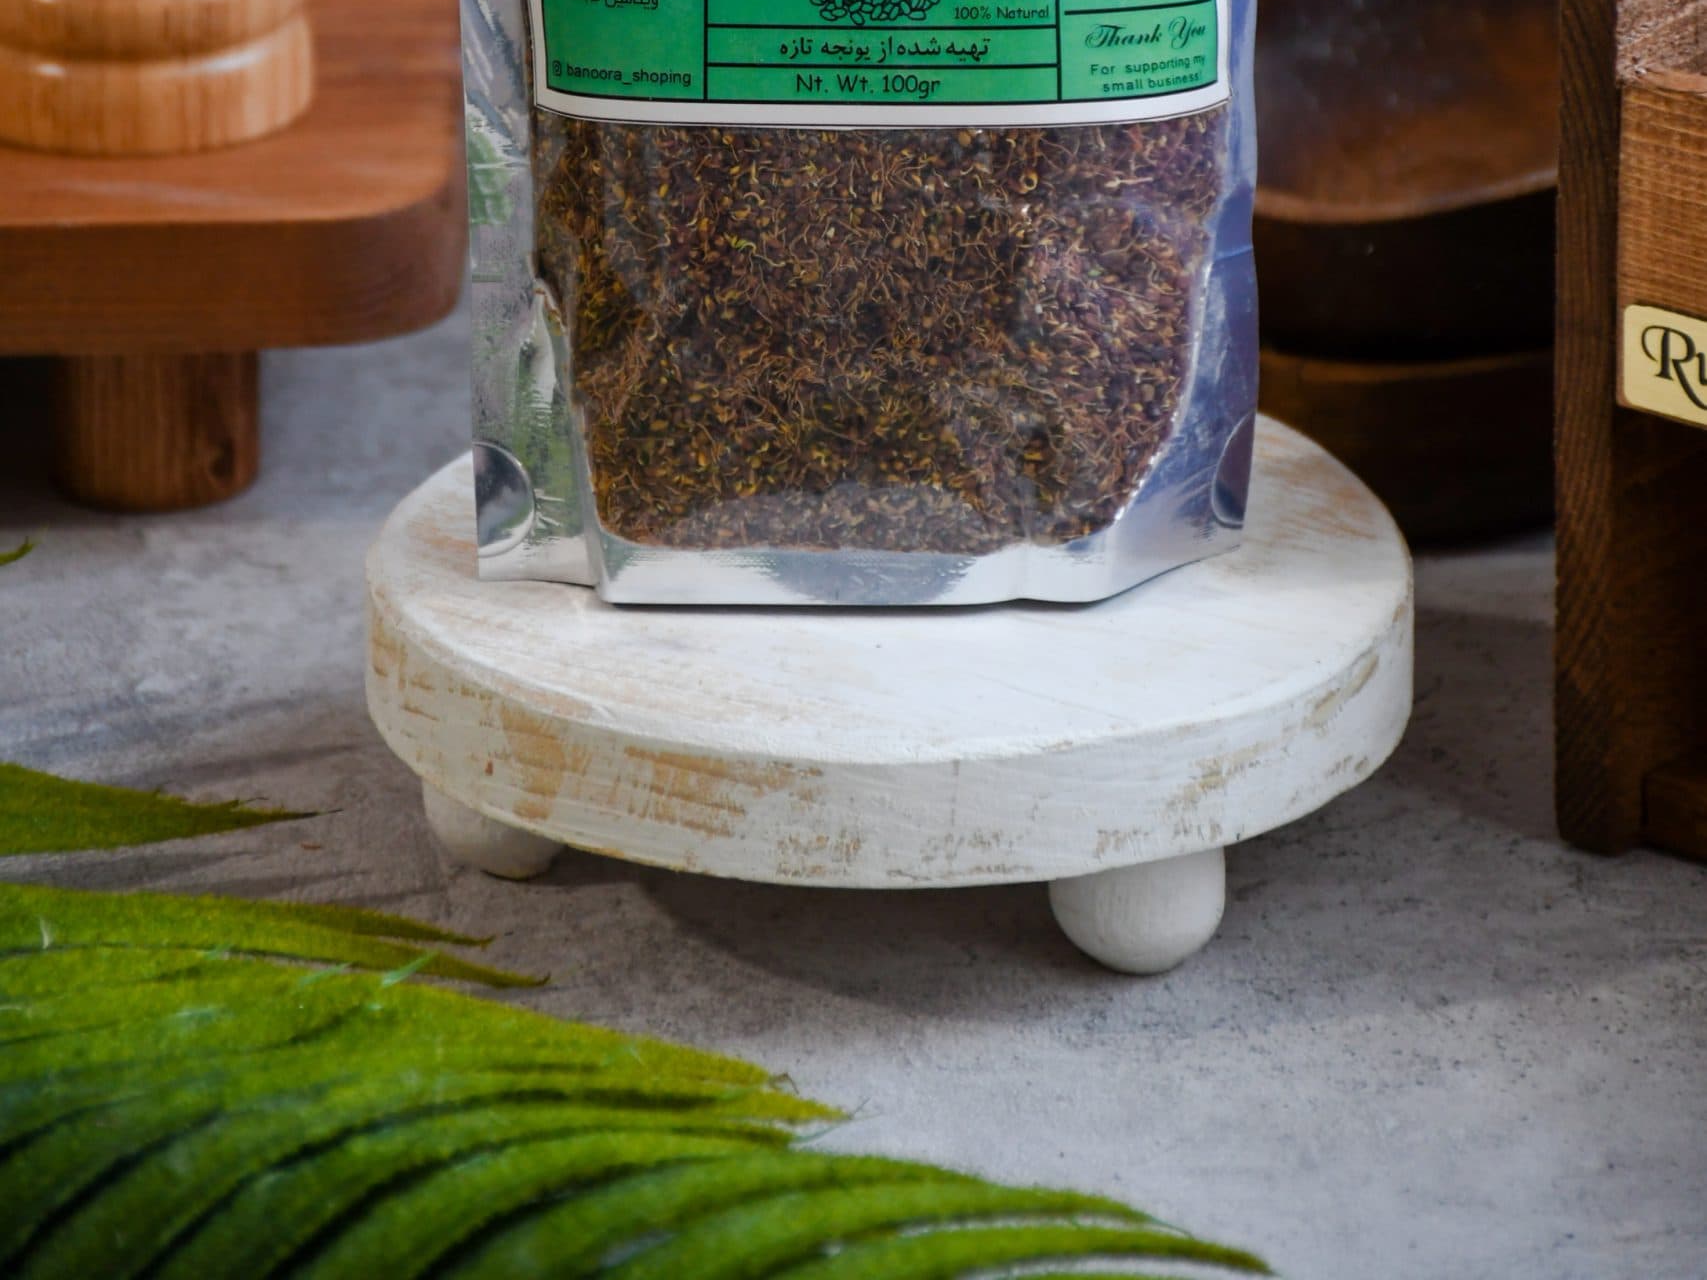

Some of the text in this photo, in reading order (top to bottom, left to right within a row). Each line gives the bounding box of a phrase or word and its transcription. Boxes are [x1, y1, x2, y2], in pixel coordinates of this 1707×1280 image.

[953, 6, 1050, 20] 100% Natural
[1085, 16, 1206, 50] Thank You
[779, 36, 989, 63] تهیه شده از یونجه تازه
[567, 64, 691, 86] banoora_shoping
[1090, 55, 1205, 76] For supporting my
[796, 74, 940, 98] Nt. Wt. 100gr
[1103, 78, 1143, 93] small
